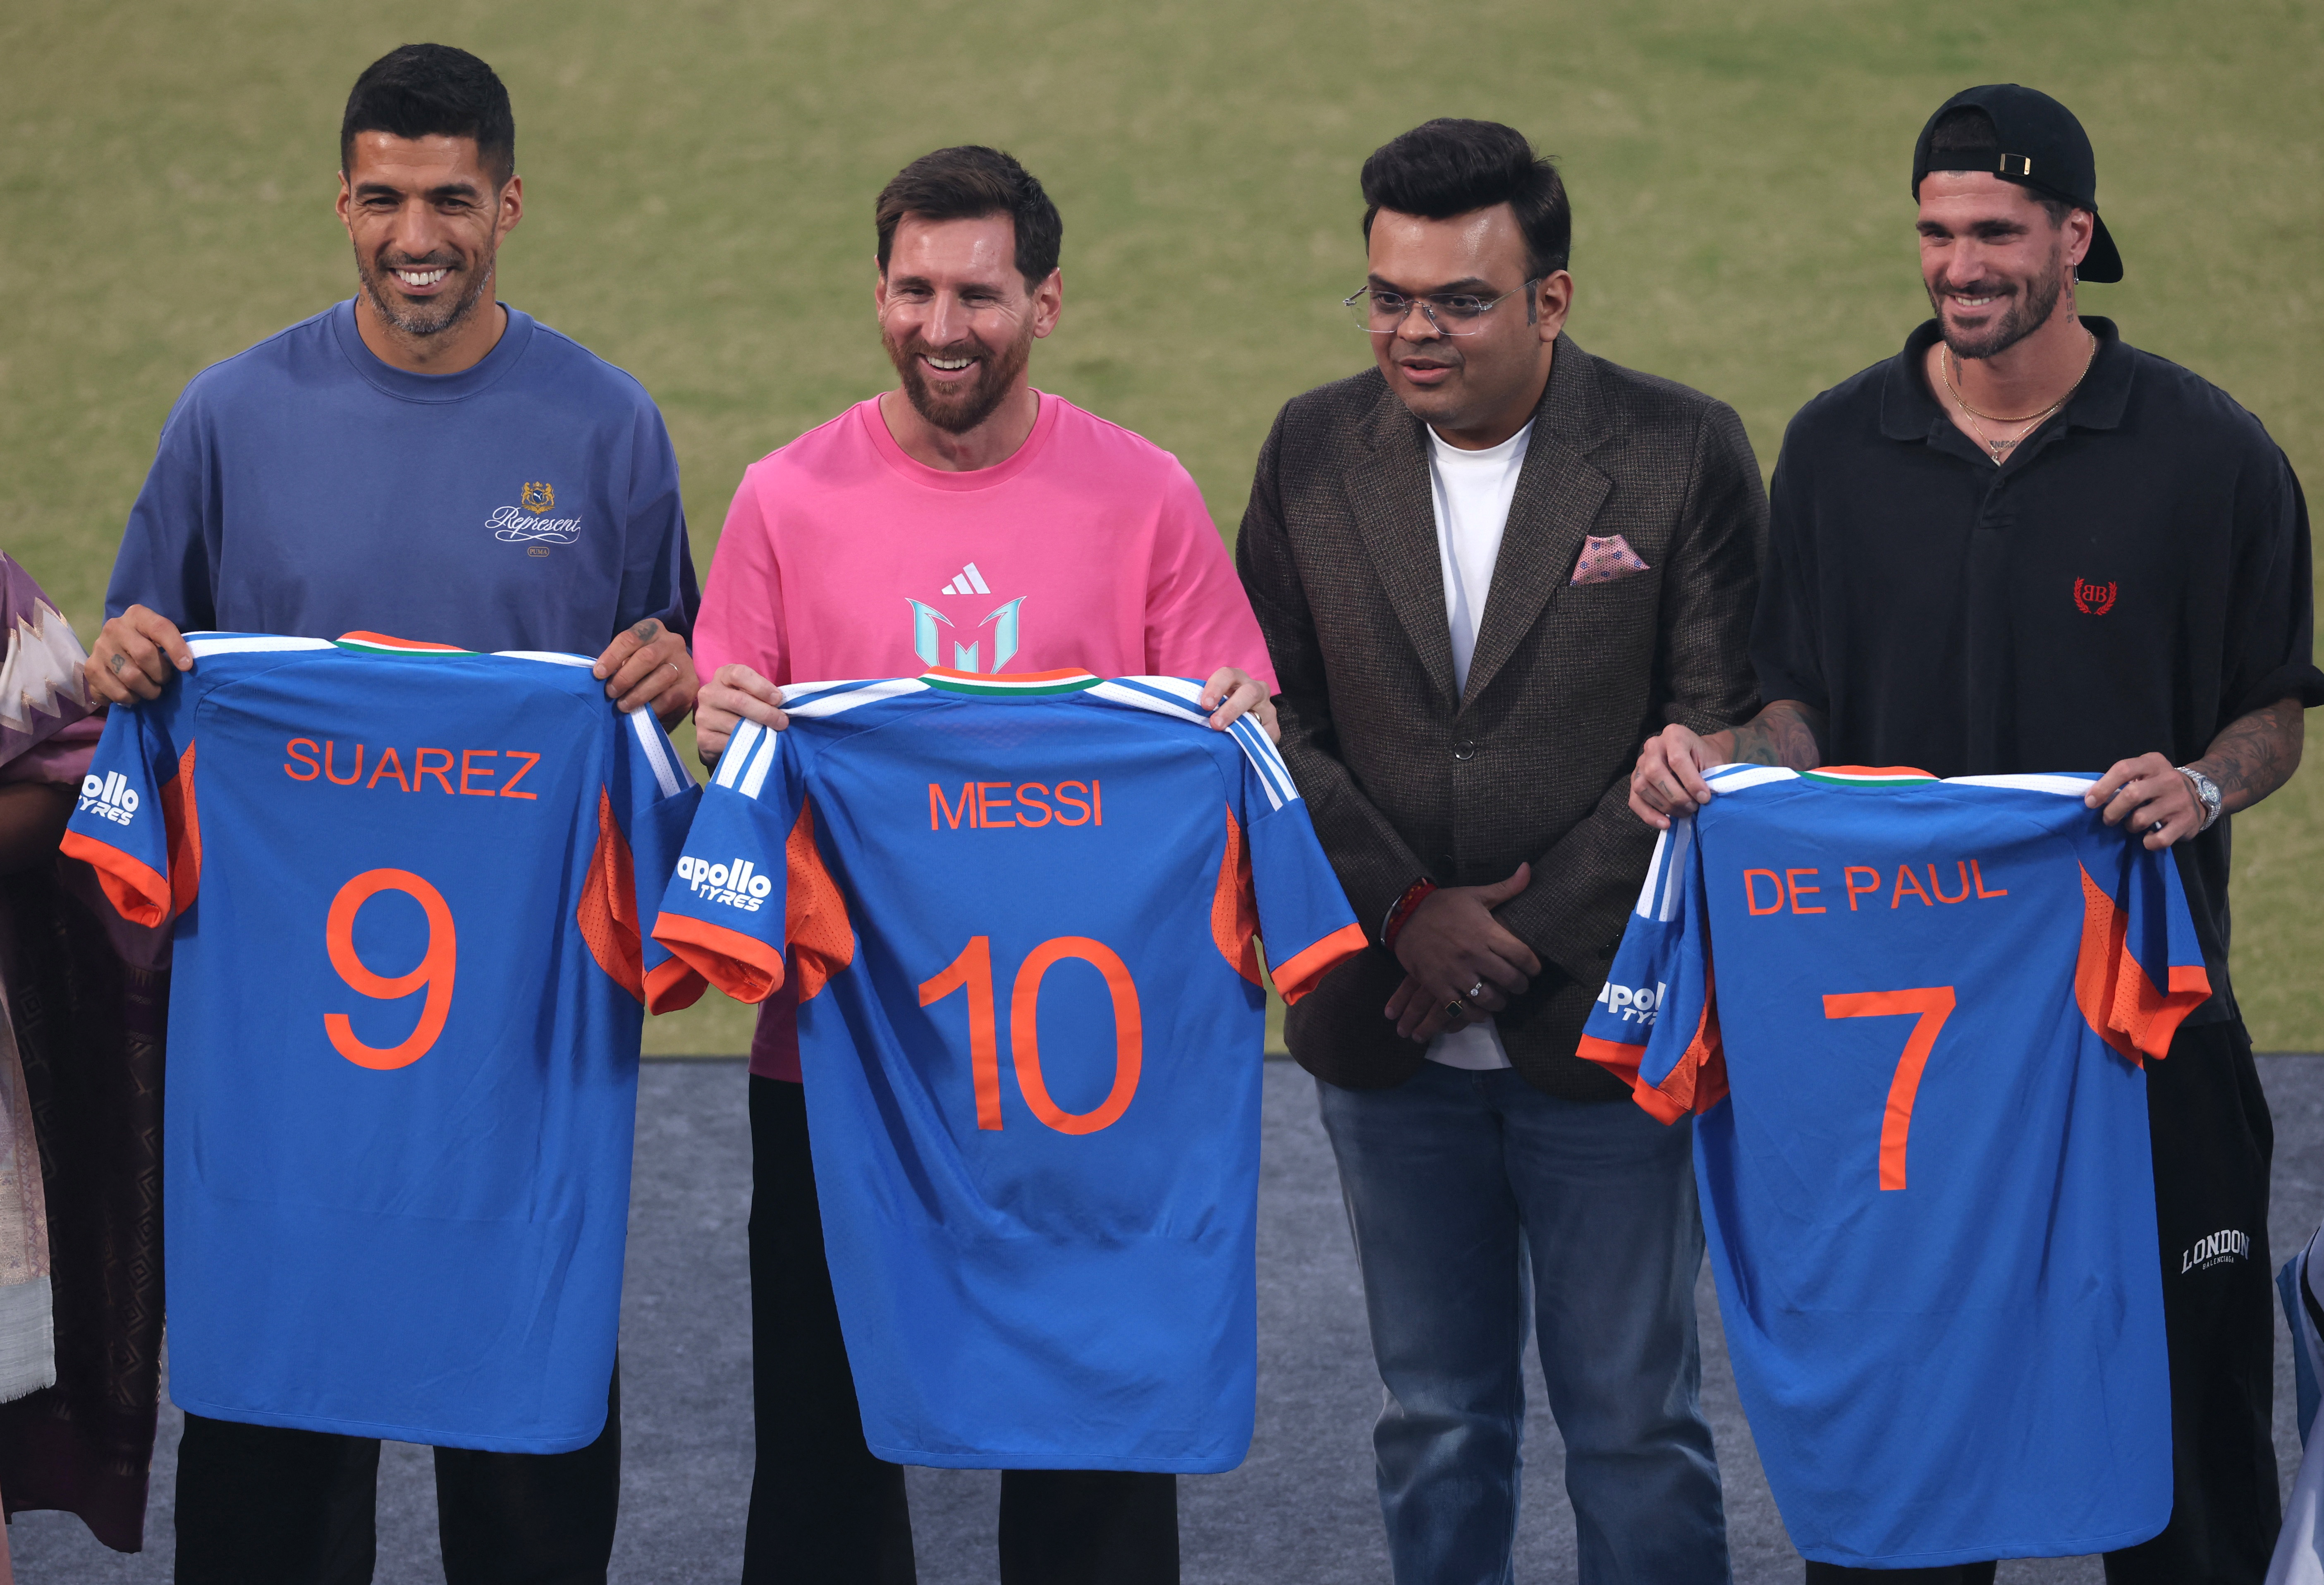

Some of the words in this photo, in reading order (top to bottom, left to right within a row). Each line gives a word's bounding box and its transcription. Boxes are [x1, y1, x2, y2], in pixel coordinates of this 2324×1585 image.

[485, 506, 582, 544] Represent
[284, 738, 540, 800] SUAREZ
[929, 780, 1102, 830] MESSI
[677, 856, 772, 898] apollo
[699, 884, 764, 912] TYRES
[1743, 868, 1826, 916] DE
[1844, 859, 2008, 911] PAUL
[325, 868, 456, 1070] 9
[918, 936, 1142, 1135] 10
[1822, 986, 1956, 1191] 7
[2181, 1229, 2250, 1274] LONDON
[2202, 1255, 2234, 1270] BALENCIAGA
